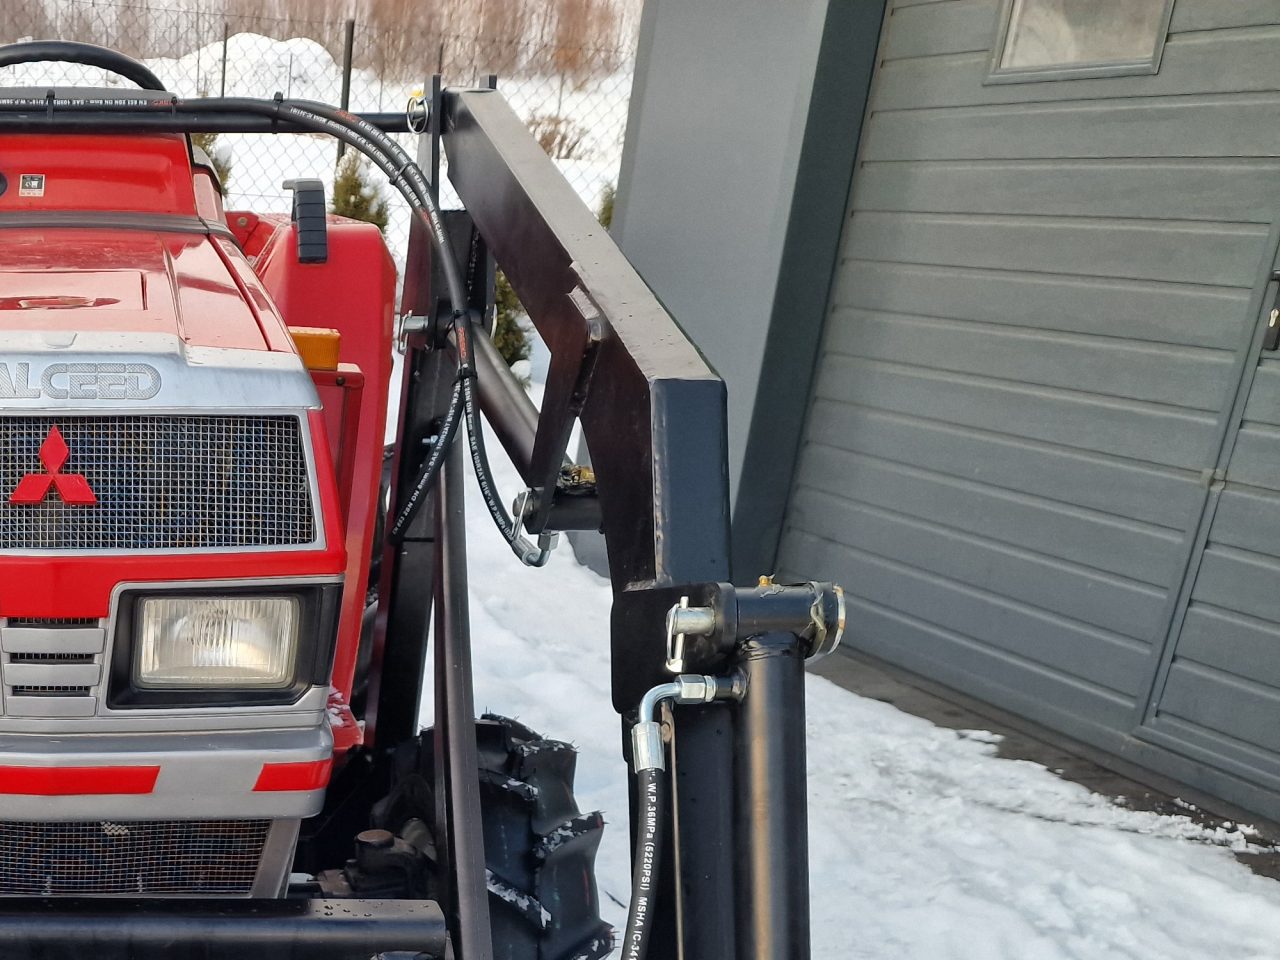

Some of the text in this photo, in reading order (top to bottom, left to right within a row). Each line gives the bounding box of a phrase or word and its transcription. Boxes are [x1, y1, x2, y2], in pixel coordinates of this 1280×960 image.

[646, 782, 656, 838] W.P.36MPa
[640, 841, 656, 891] (5220PSI)
[634, 896, 648, 927] MSHA
